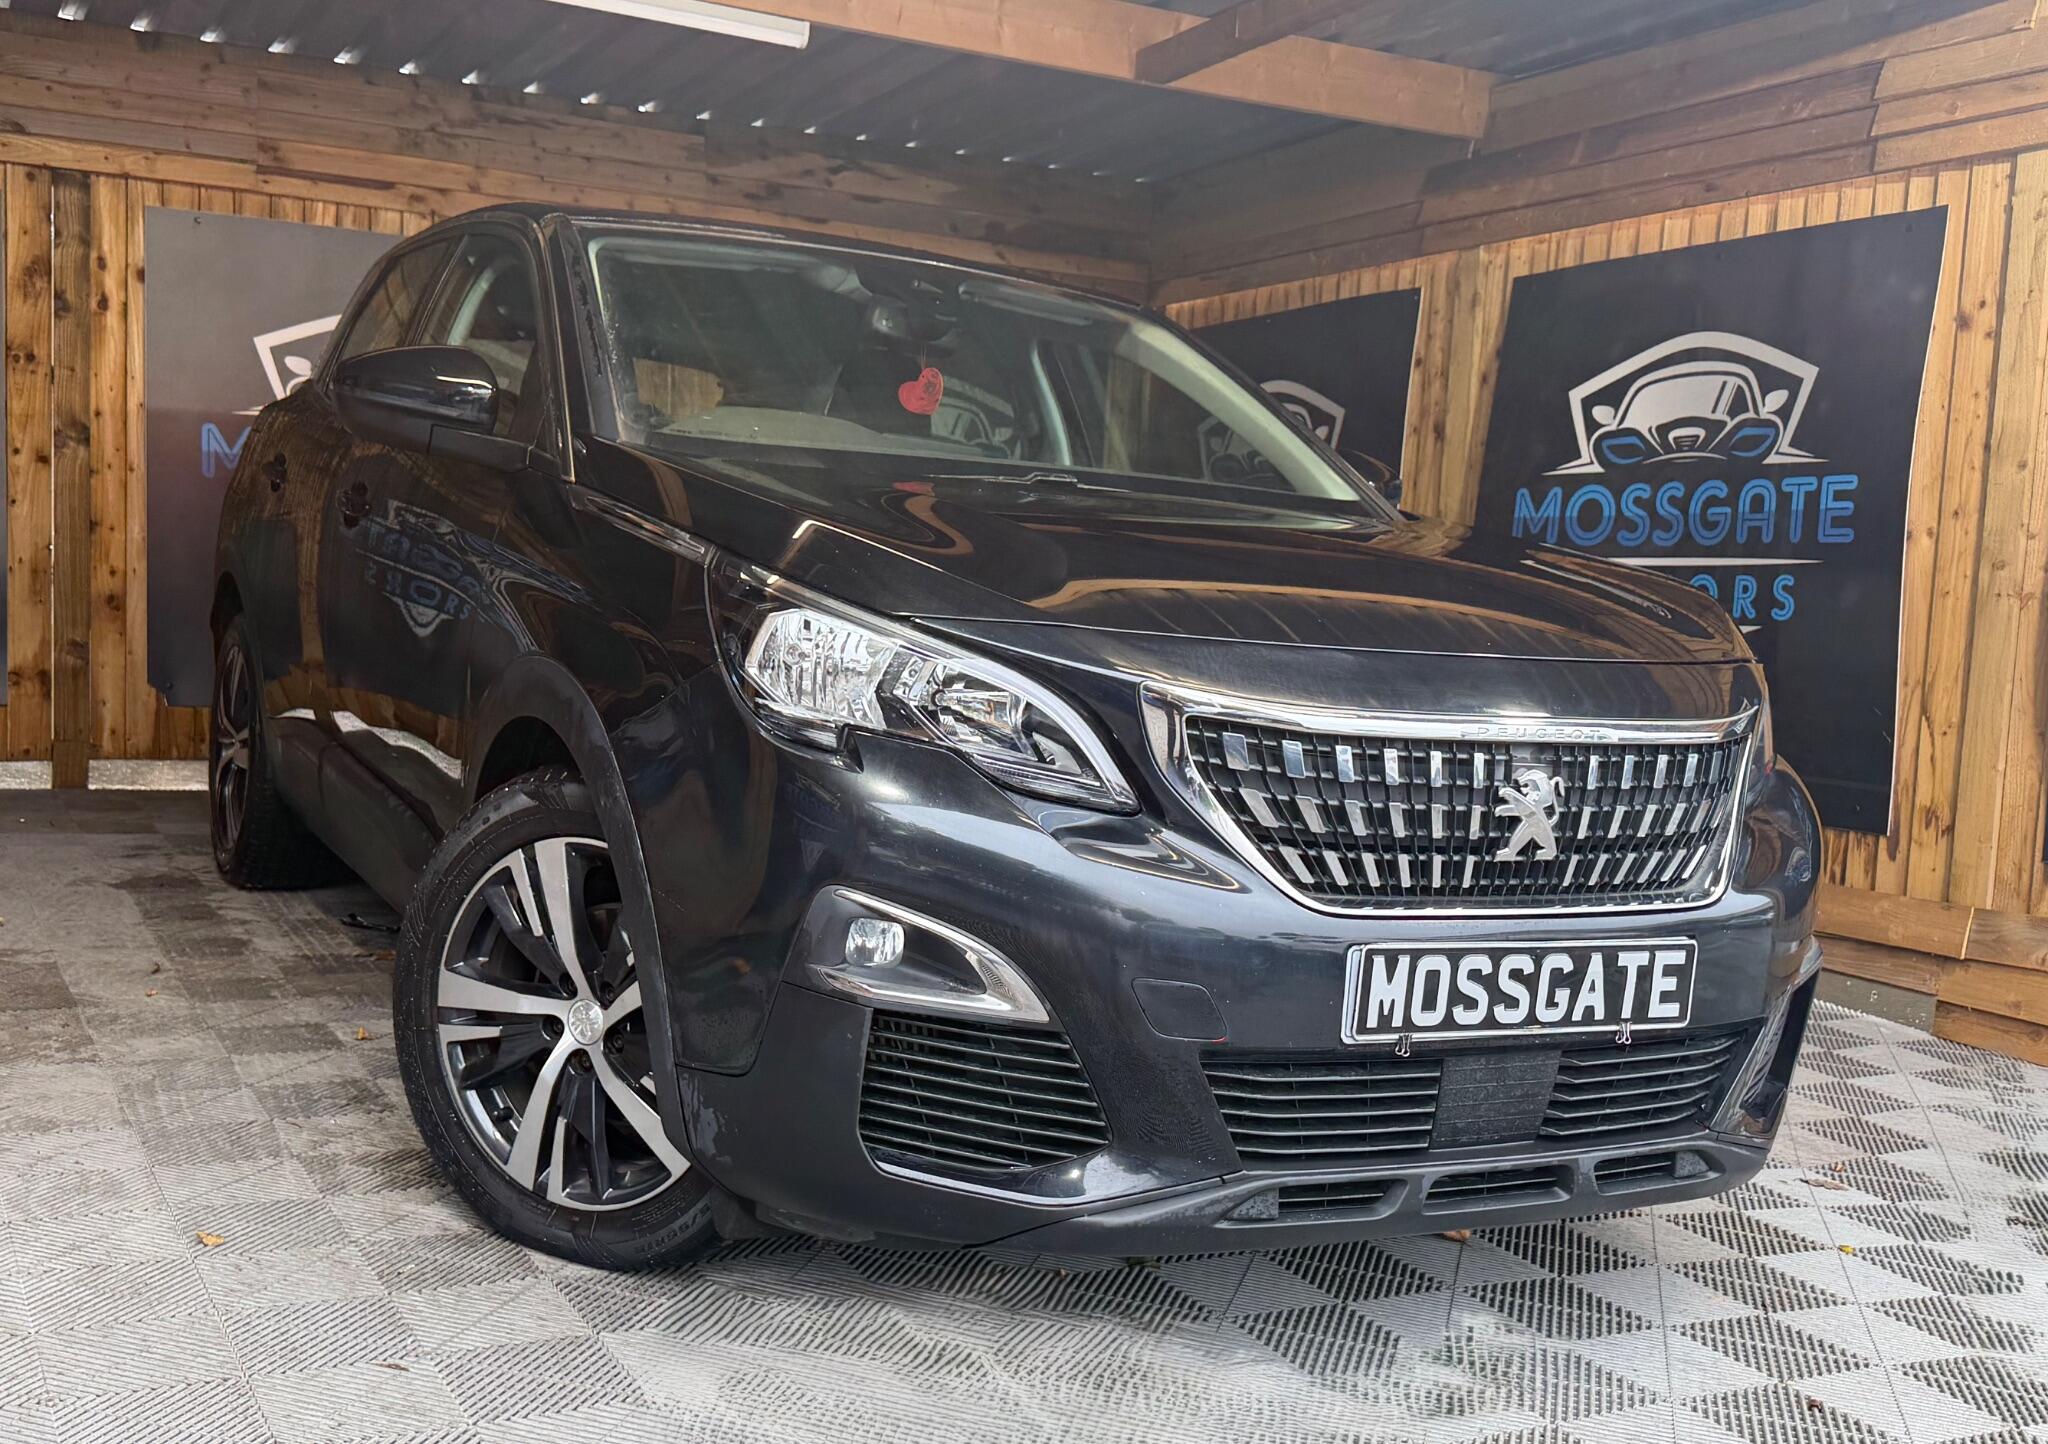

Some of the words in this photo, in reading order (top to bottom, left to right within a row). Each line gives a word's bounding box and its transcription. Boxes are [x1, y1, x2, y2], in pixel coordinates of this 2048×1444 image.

[1512, 474, 1859, 546] MOSSGATE
[1477, 727, 1601, 741] PEUGEOT
[1366, 950, 1686, 1028] MOSSGATE
